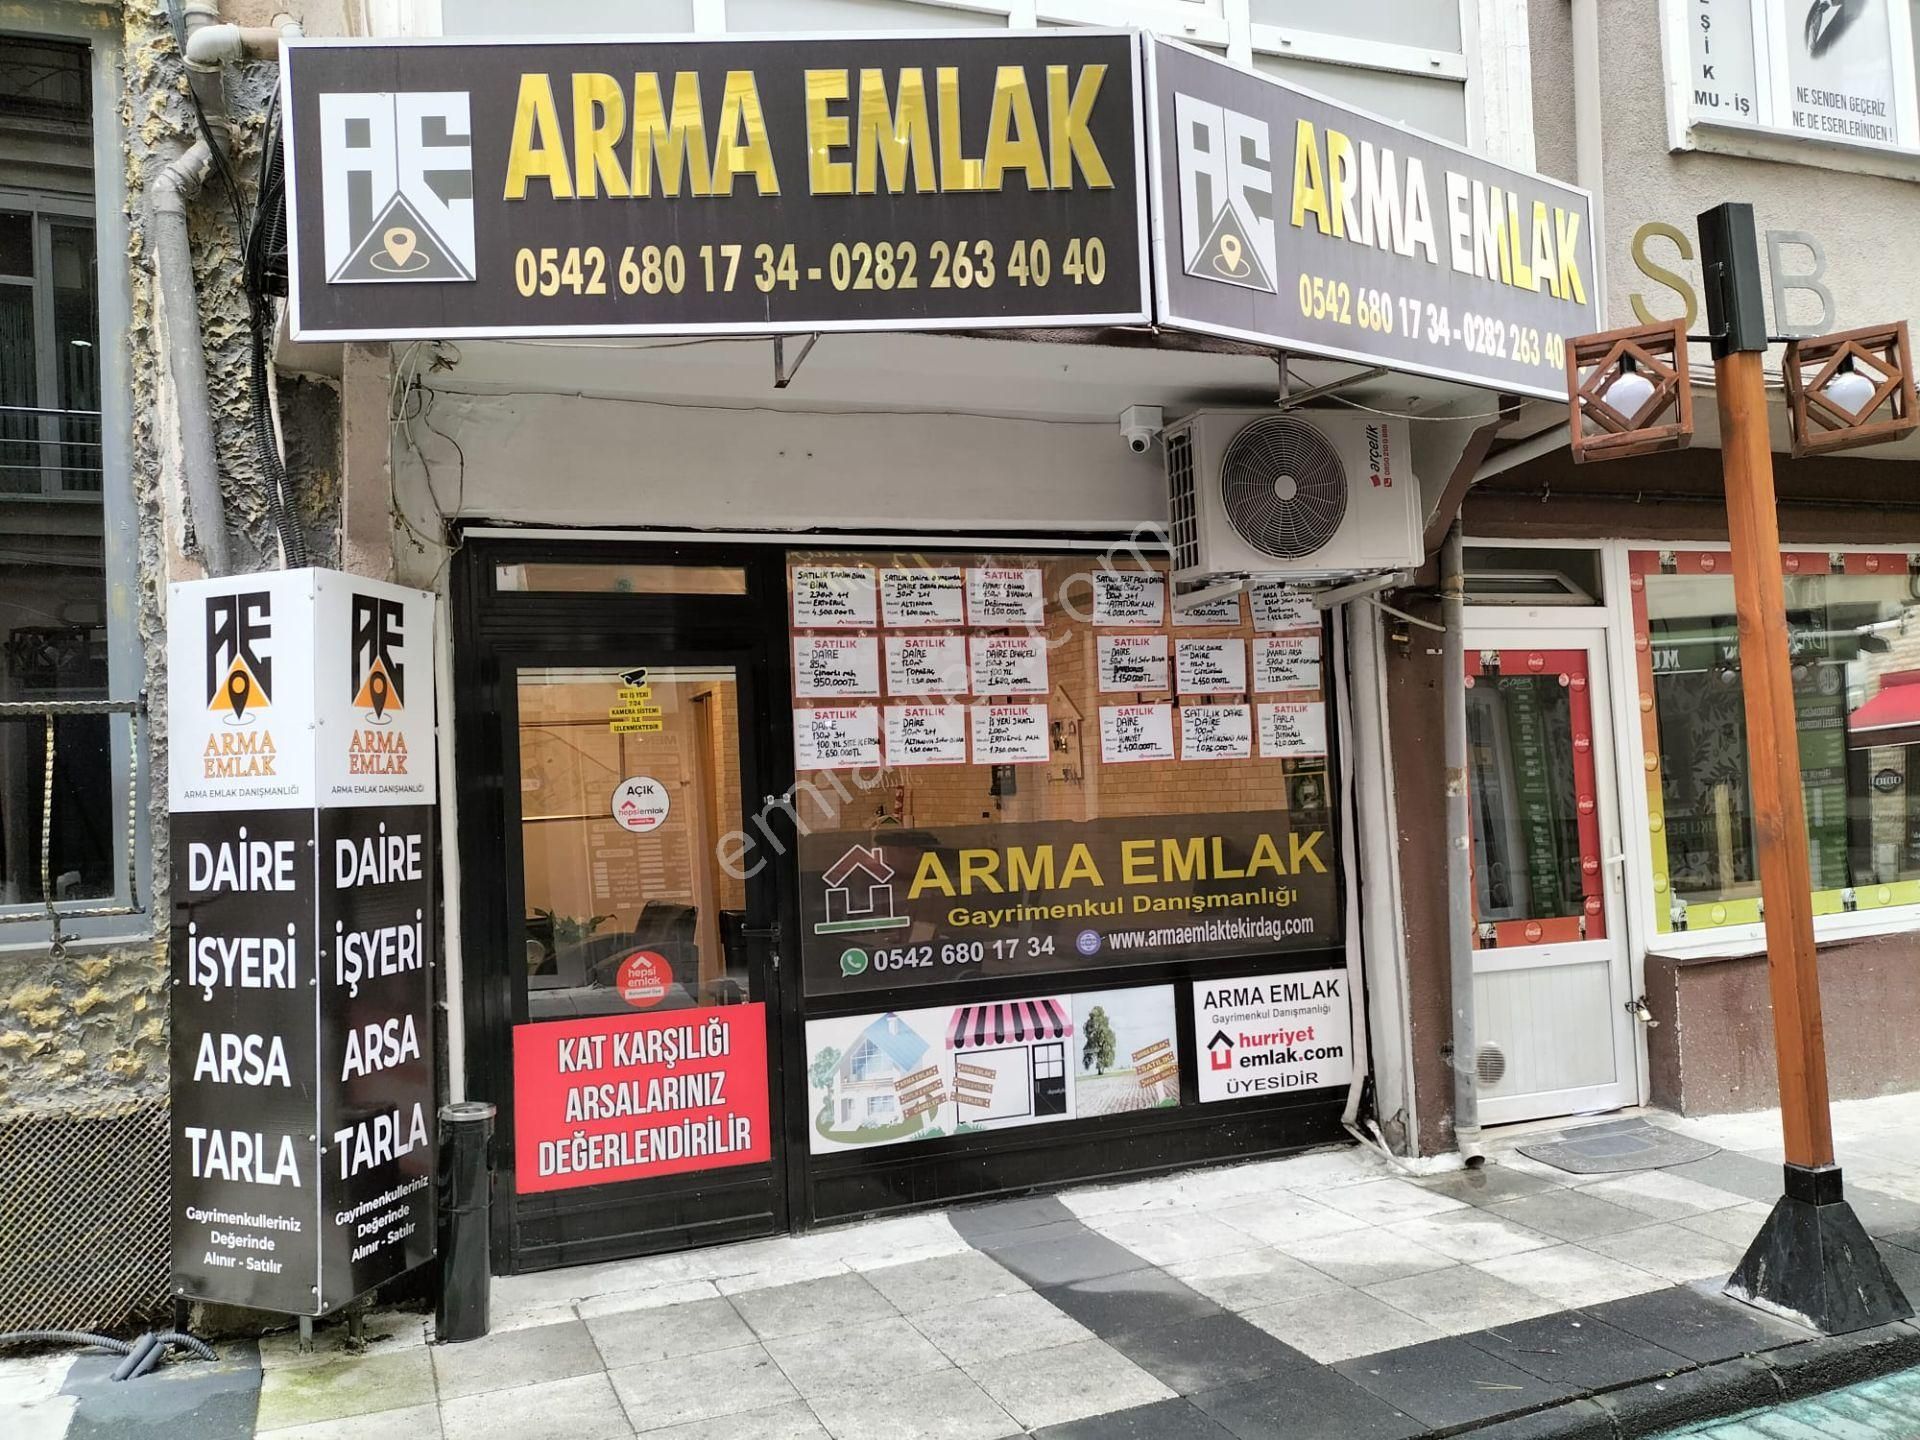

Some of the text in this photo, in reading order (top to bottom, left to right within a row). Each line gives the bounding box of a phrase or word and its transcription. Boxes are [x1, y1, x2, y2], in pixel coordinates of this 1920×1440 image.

[1797, 86, 1886, 117] NE SENDEN GEÇERİZ
[504, 65, 1115, 199] ARMA EMLAK
[1793, 110, 1805, 128] NE
[1807, 113, 1819, 130] DE
[1821, 115, 1888, 142] ESERLERİNDEN
[1291, 119, 1586, 305] ARMA EMLAK
[515, 246, 607, 297] 0542
[618, 245, 686, 295] 680
[700, 243, 742, 293] 17
[930, 239, 995, 288] 263
[1008, 238, 1050, 287] 40
[1062, 236, 1106, 285] 40
[1300, 273, 1351, 325] 0542
[1357, 286, 1393, 334] 680
[1399, 297, 1421, 339] 17
[1510, 324, 1540, 365] 263
[1545, 334, 1564, 370] 40
[1366, 424, 1382, 472] arçelik
[985, 571, 1024, 579] SATILIK
[811, 649, 839, 659] DAİRE
[814, 640, 857, 648] SATILIK
[902, 648, 927, 659] DAİRE
[989, 640, 1028, 648] SATILIK
[1268, 640, 1303, 648] SATILIK
[815, 711, 857, 720] SATILIK
[903, 717, 924, 727] DAİRE
[904, 708, 945, 716] SATILIK
[990, 708, 1029, 716] SATILIK
[1117, 708, 1154, 716] SATILIK
[1274, 705, 1308, 713] SATILIK
[203, 730, 276, 757] ARMA
[349, 729, 407, 754] ARMA
[204, 755, 276, 779] EMLAK
[349, 754, 407, 775] EMLAK
[184, 784, 299, 799] ARMA EMLAK DANIŞMANLIĞI
[332, 784, 424, 794] ARMA EMLAK DANIŞMANLIĞI
[627, 785, 654, 797] AÇIK
[618, 806, 664, 816] hepsiemlak
[189, 826, 296, 892] DAİRE
[335, 821, 422, 889] DAİRE
[908, 831, 1327, 899] ARMA EMLAK
[948, 886, 1297, 928] Gayrimenkul Danışmanlığı
[1109, 916, 1313, 950] www.armaemlaktekirdag.com
[189, 921, 296, 1002] İŞYERİ
[336, 908, 423, 998] İŞYERİ
[874, 935, 1055, 971] 0542 680 17 34
[628, 966, 656, 978] hepsi
[628, 976, 661, 987] emlak
[1204, 979, 1340, 1010] ARMA EMLAK
[1212, 1004, 1331, 1025] Gayrimenkul Danışmanlığı
[341, 1013, 421, 1082] ARSA
[558, 1016, 729, 1073] KAT KARŞILIĞI
[1239, 1026, 1314, 1048] hurriyet
[193, 1032, 292, 1088] ARSA
[1240, 1045, 1343, 1068] emlak.com
[1227, 1071, 1319, 1094] ÜYESİDİR
[565, 1071, 726, 1123] ARSALARINIZ
[334, 1102, 428, 1180] TARLA
[539, 1113, 751, 1177] DEĞERLENDİRİLİR
[185, 1127, 301, 1188] TARLA
[335, 1175, 429, 1226] Gayrimenkulleriniz
[186, 1206, 301, 1233] Gayrimenkulleriniz
[357, 1204, 410, 1238] Değerinde
[211, 1231, 275, 1251] Değerinde
[351, 1239, 379, 1263] Alınır
[387, 1221, 416, 1245] Satılır
[204, 1252, 235, 1268] Alınır
[246, 1256, 283, 1274] Satılır
